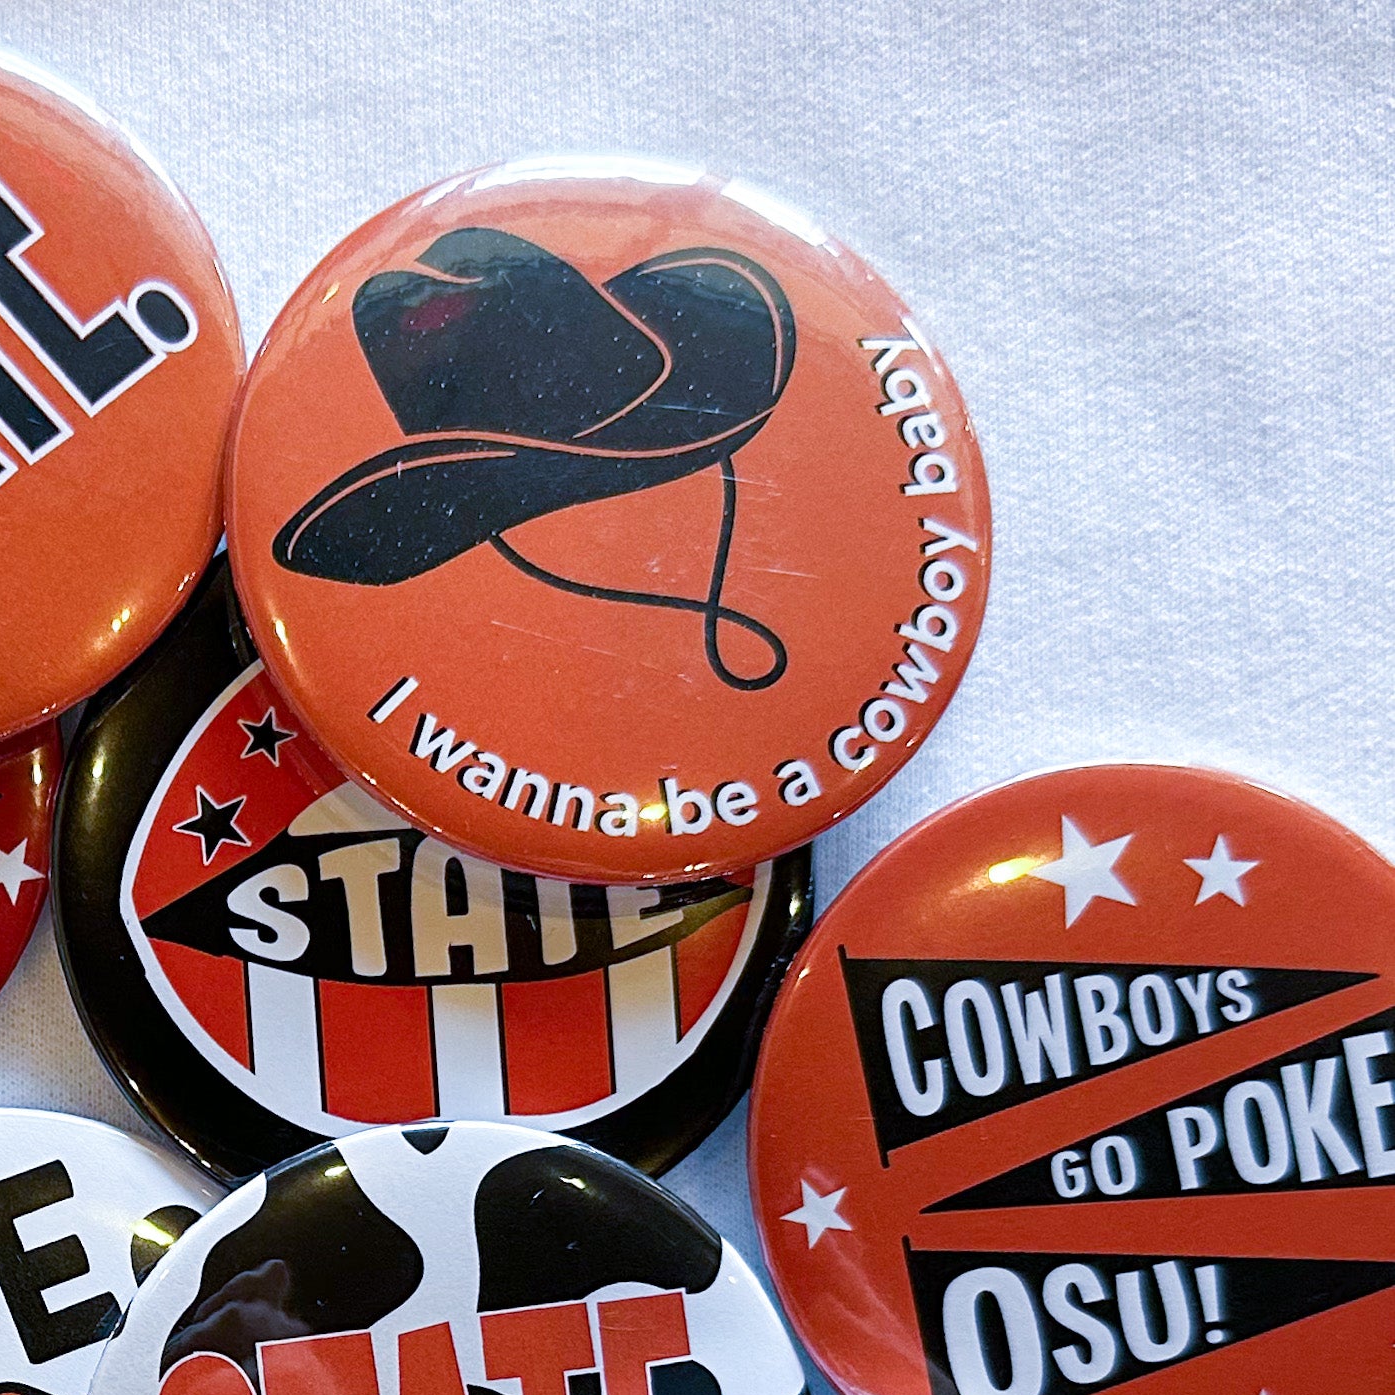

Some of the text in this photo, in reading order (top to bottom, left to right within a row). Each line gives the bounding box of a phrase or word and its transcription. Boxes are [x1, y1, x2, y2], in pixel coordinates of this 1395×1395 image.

[369, 335, 978, 838] I wanna be a cowboy baby
[881, 968, 1256, 1117] COWBOYS
[1052, 1136, 1137, 1199] GO
